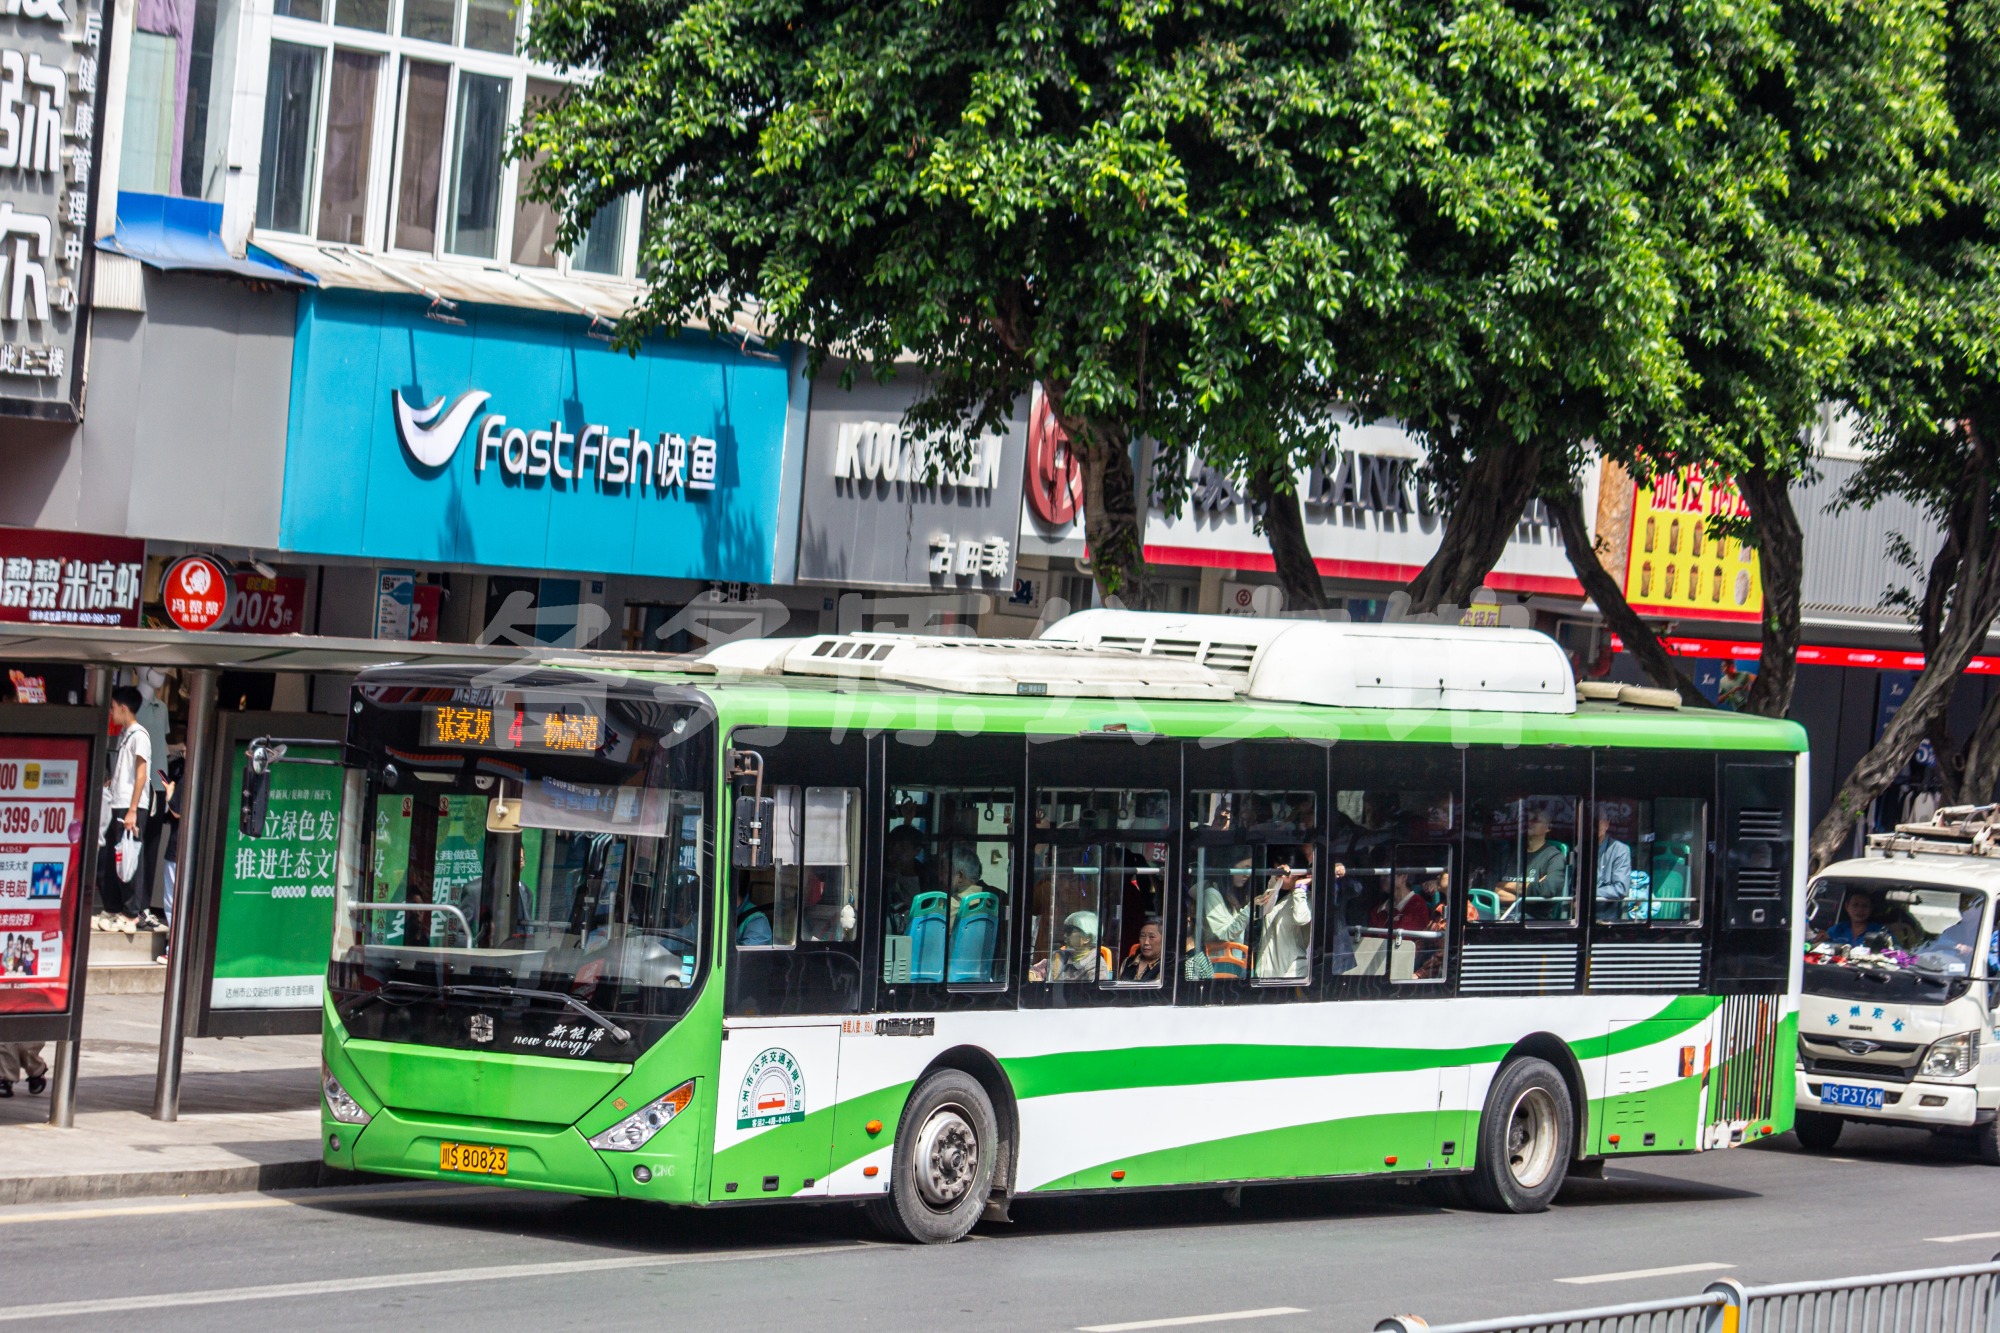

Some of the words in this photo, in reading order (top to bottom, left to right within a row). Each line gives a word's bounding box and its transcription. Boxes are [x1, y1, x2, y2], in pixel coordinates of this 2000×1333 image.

[654, 432, 717, 490] 快鱼
[929, 533, 1009, 578] 古田森
[0, 556, 142, 610] 黎黎米凉虾
[507, 711, 524, 747] 4
[543, 713, 599, 750] 物流港
[238, 810, 341, 842] 立绿色发
[513, 1033, 541, 1046] new
[544, 1036, 595, 1057] energy
[549, 1024, 605, 1041] 新能源
[741, 1051, 802, 1118] 达州市公共交通有限公司
